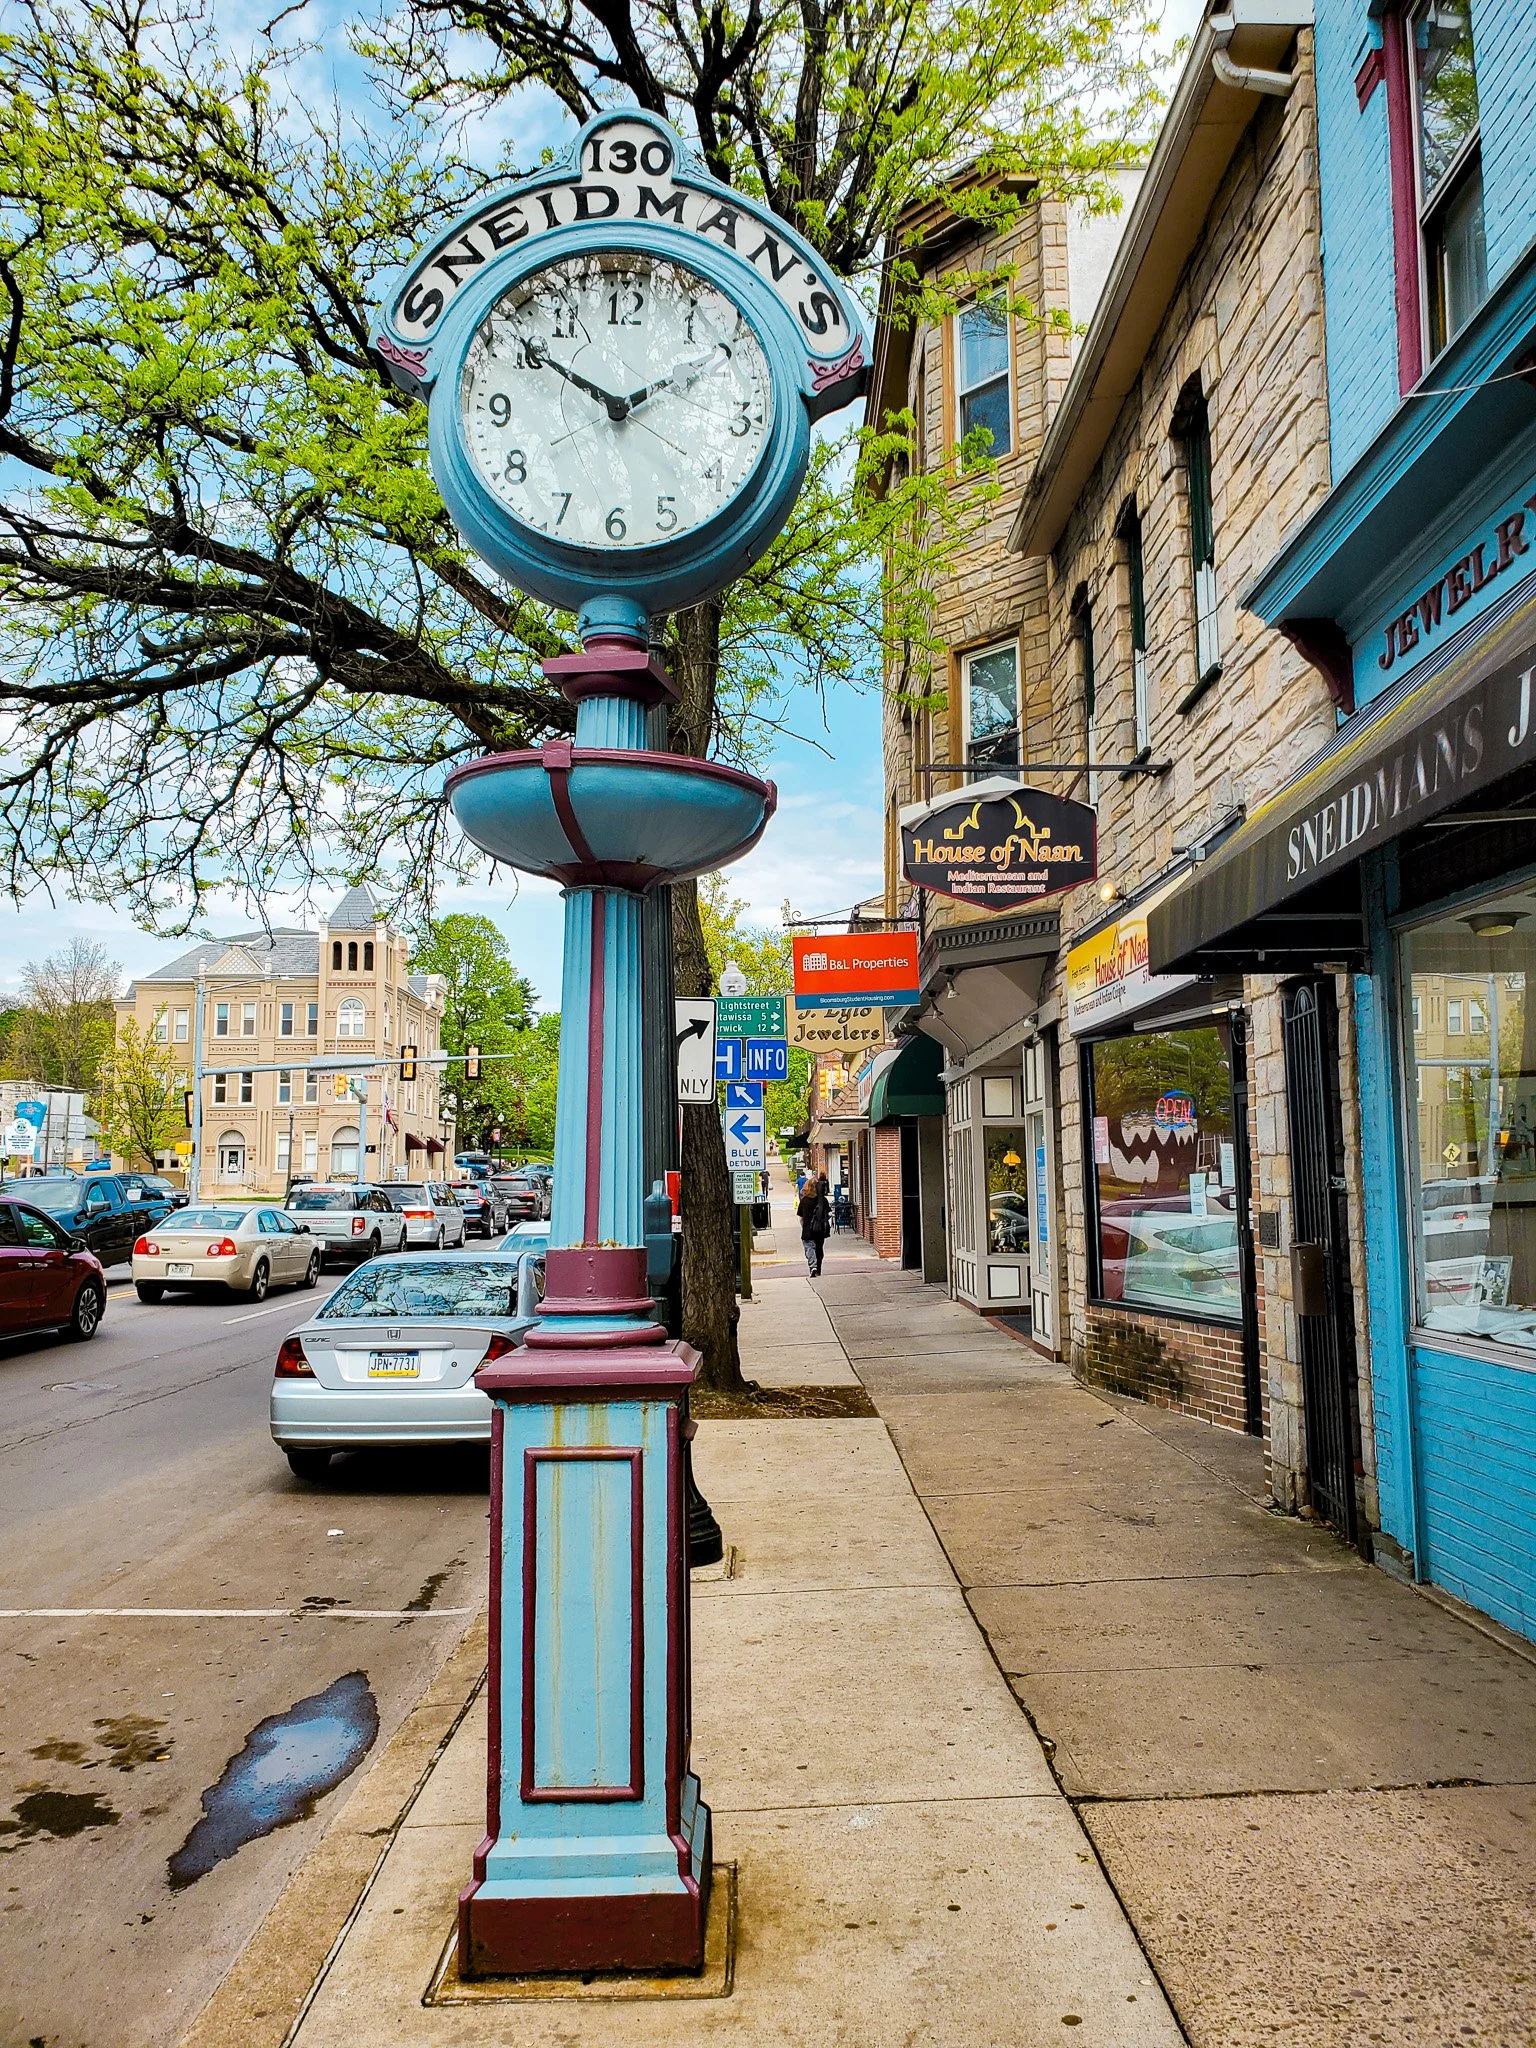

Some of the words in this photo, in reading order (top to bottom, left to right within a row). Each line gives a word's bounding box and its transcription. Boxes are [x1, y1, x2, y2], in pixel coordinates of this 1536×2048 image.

[587, 139, 673, 177] 130
[403, 185, 840, 336] SNEIDMAN'S
[607, 290, 644, 326] 12
[489, 393, 512, 428] 9
[728, 401, 752, 437] 3
[503, 450, 528, 486] 8
[702, 457, 725, 493] 4
[552, 492, 573, 526] 7
[605, 507, 627, 541] 6
[656, 496, 677, 531] 5
[1287, 703, 1485, 882] SNEIDMANS
[1508, 665, 1536, 748] J
[913, 838, 985, 864] House
[990, 834, 1019, 870] of
[1018, 838, 1084, 863] Naan
[947, 869, 1026, 881] Mediterranean
[1027, 868, 1048, 881] and
[951, 882, 985, 894] Indian
[988, 882, 1046, 894] Restaurant
[829, 959, 850, 971] B&L
[852, 957, 909, 971] Properties
[1094, 954, 1116, 987] House
[1129, 933, 1149, 969] Naa
[719, 1013, 752, 1021] tawissa
[761, 1012, 767, 1021] 5
[720, 1001, 770, 1012] Lightstreet
[776, 1001, 781, 1010] 3
[757, 1023, 767, 1032] 12
[793, 1023, 881, 1043] Jewelers
[748, 1048, 785, 1071] INFO
[680, 1078, 709, 1094] NLY
[1155, 1097, 1192, 1123] OPEN
[731, 1149, 759, 1157] BLUE
